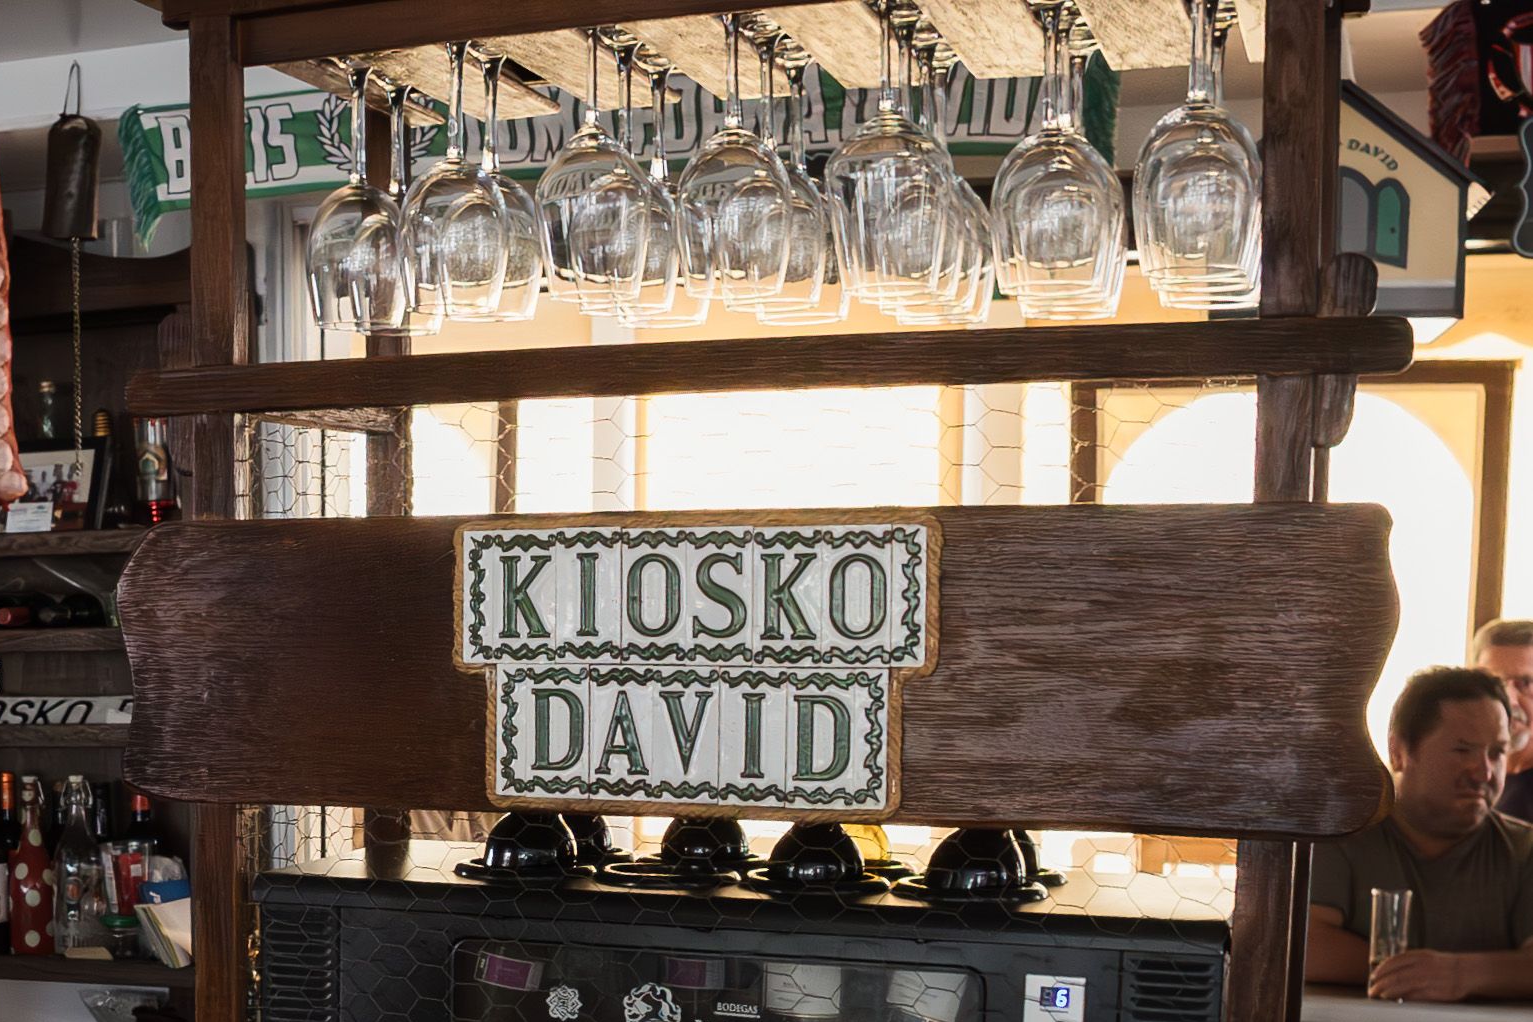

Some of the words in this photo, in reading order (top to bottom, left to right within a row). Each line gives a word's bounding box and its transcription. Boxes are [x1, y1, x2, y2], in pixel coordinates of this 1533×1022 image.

[156, 103, 300, 195] BIS
[1346, 138, 1400, 172] DAVID
[497, 551, 889, 642] KIOSKO
[529, 687, 853, 782] DAVID
[716, 1001, 758, 1014] BODEGAS
